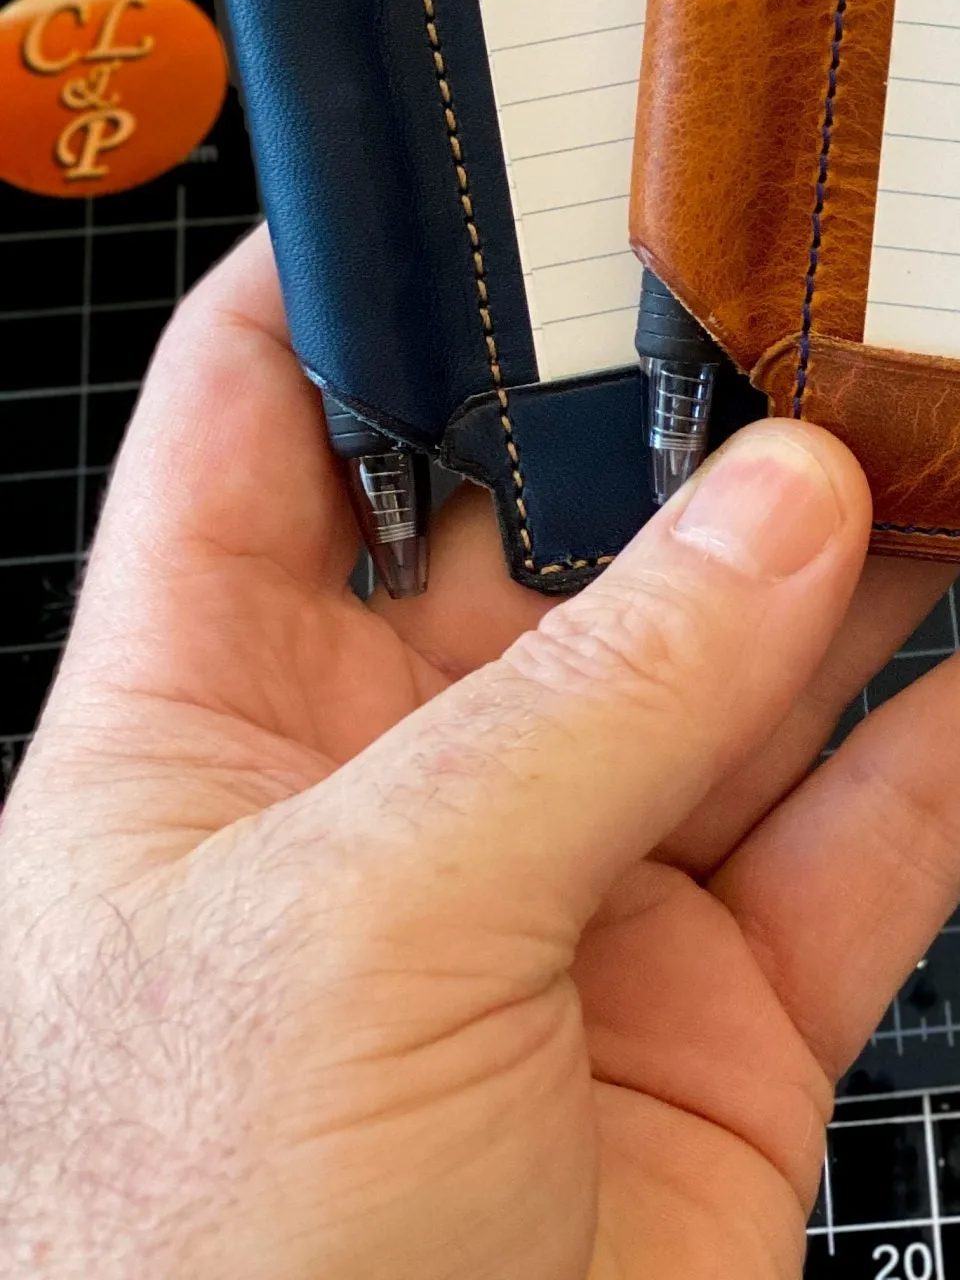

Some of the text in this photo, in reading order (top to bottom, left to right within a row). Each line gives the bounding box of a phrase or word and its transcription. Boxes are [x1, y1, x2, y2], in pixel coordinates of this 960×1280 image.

[61, 59, 122, 110] &
[55, 107, 137, 180] P
[872, 1242, 932, 1280] 20
